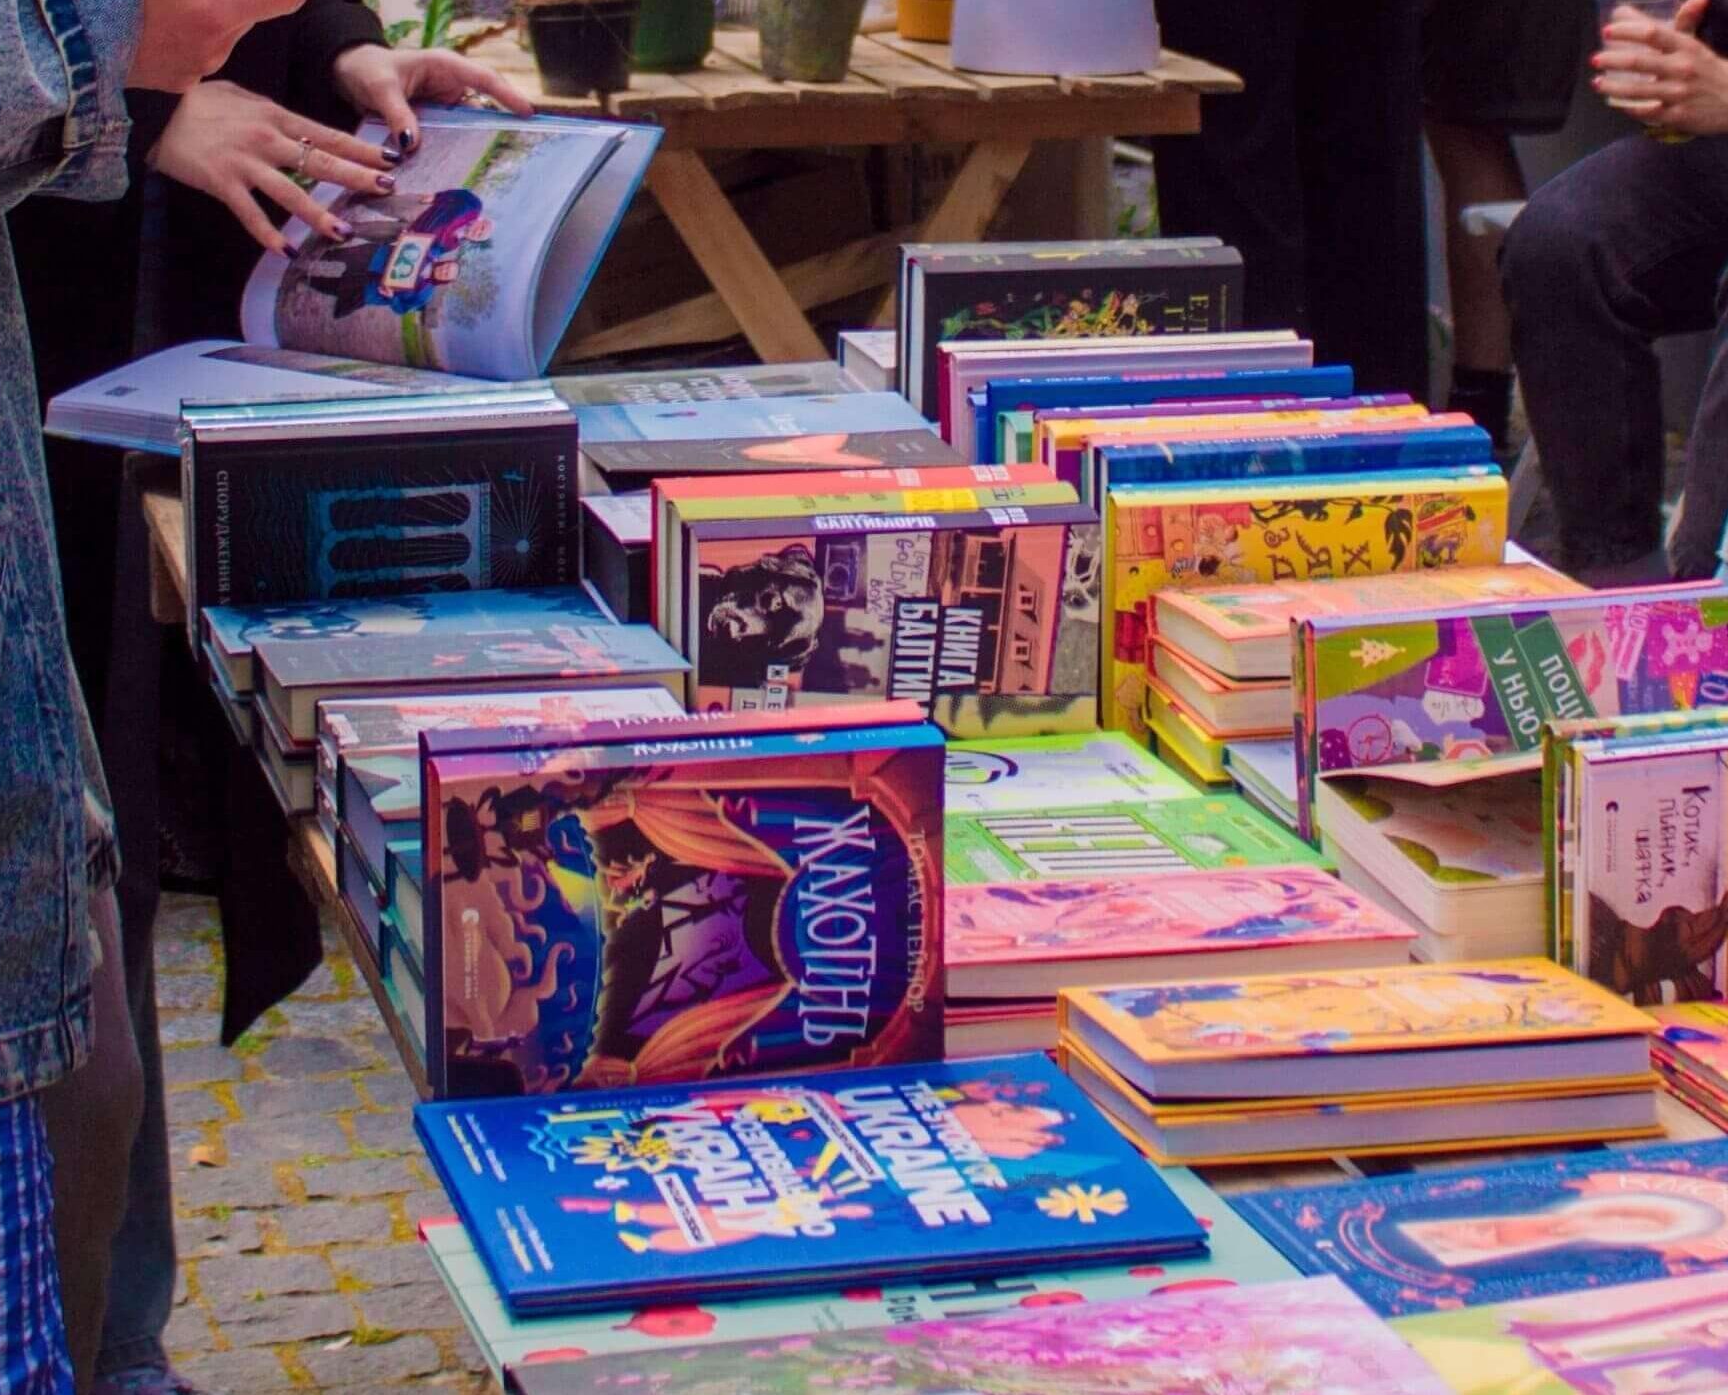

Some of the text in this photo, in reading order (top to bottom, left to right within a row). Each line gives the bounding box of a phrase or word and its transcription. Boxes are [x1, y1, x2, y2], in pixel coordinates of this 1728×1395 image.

[214, 469, 231, 594] СПОРУДЖЕННЯ
[936, 606, 984, 687] КНИГА
[1681, 785, 1712, 868] Котик,
[791, 805, 876, 1047] ЖАХОТІНЬ
[906, 827, 929, 1013] ТОМАС ТЕЙЛОР
[643, 1099, 798, 1238] УКРАЇНУ
[834, 1085, 992, 1228] UKRAINE
[924, 1107, 993, 1165] STORY
